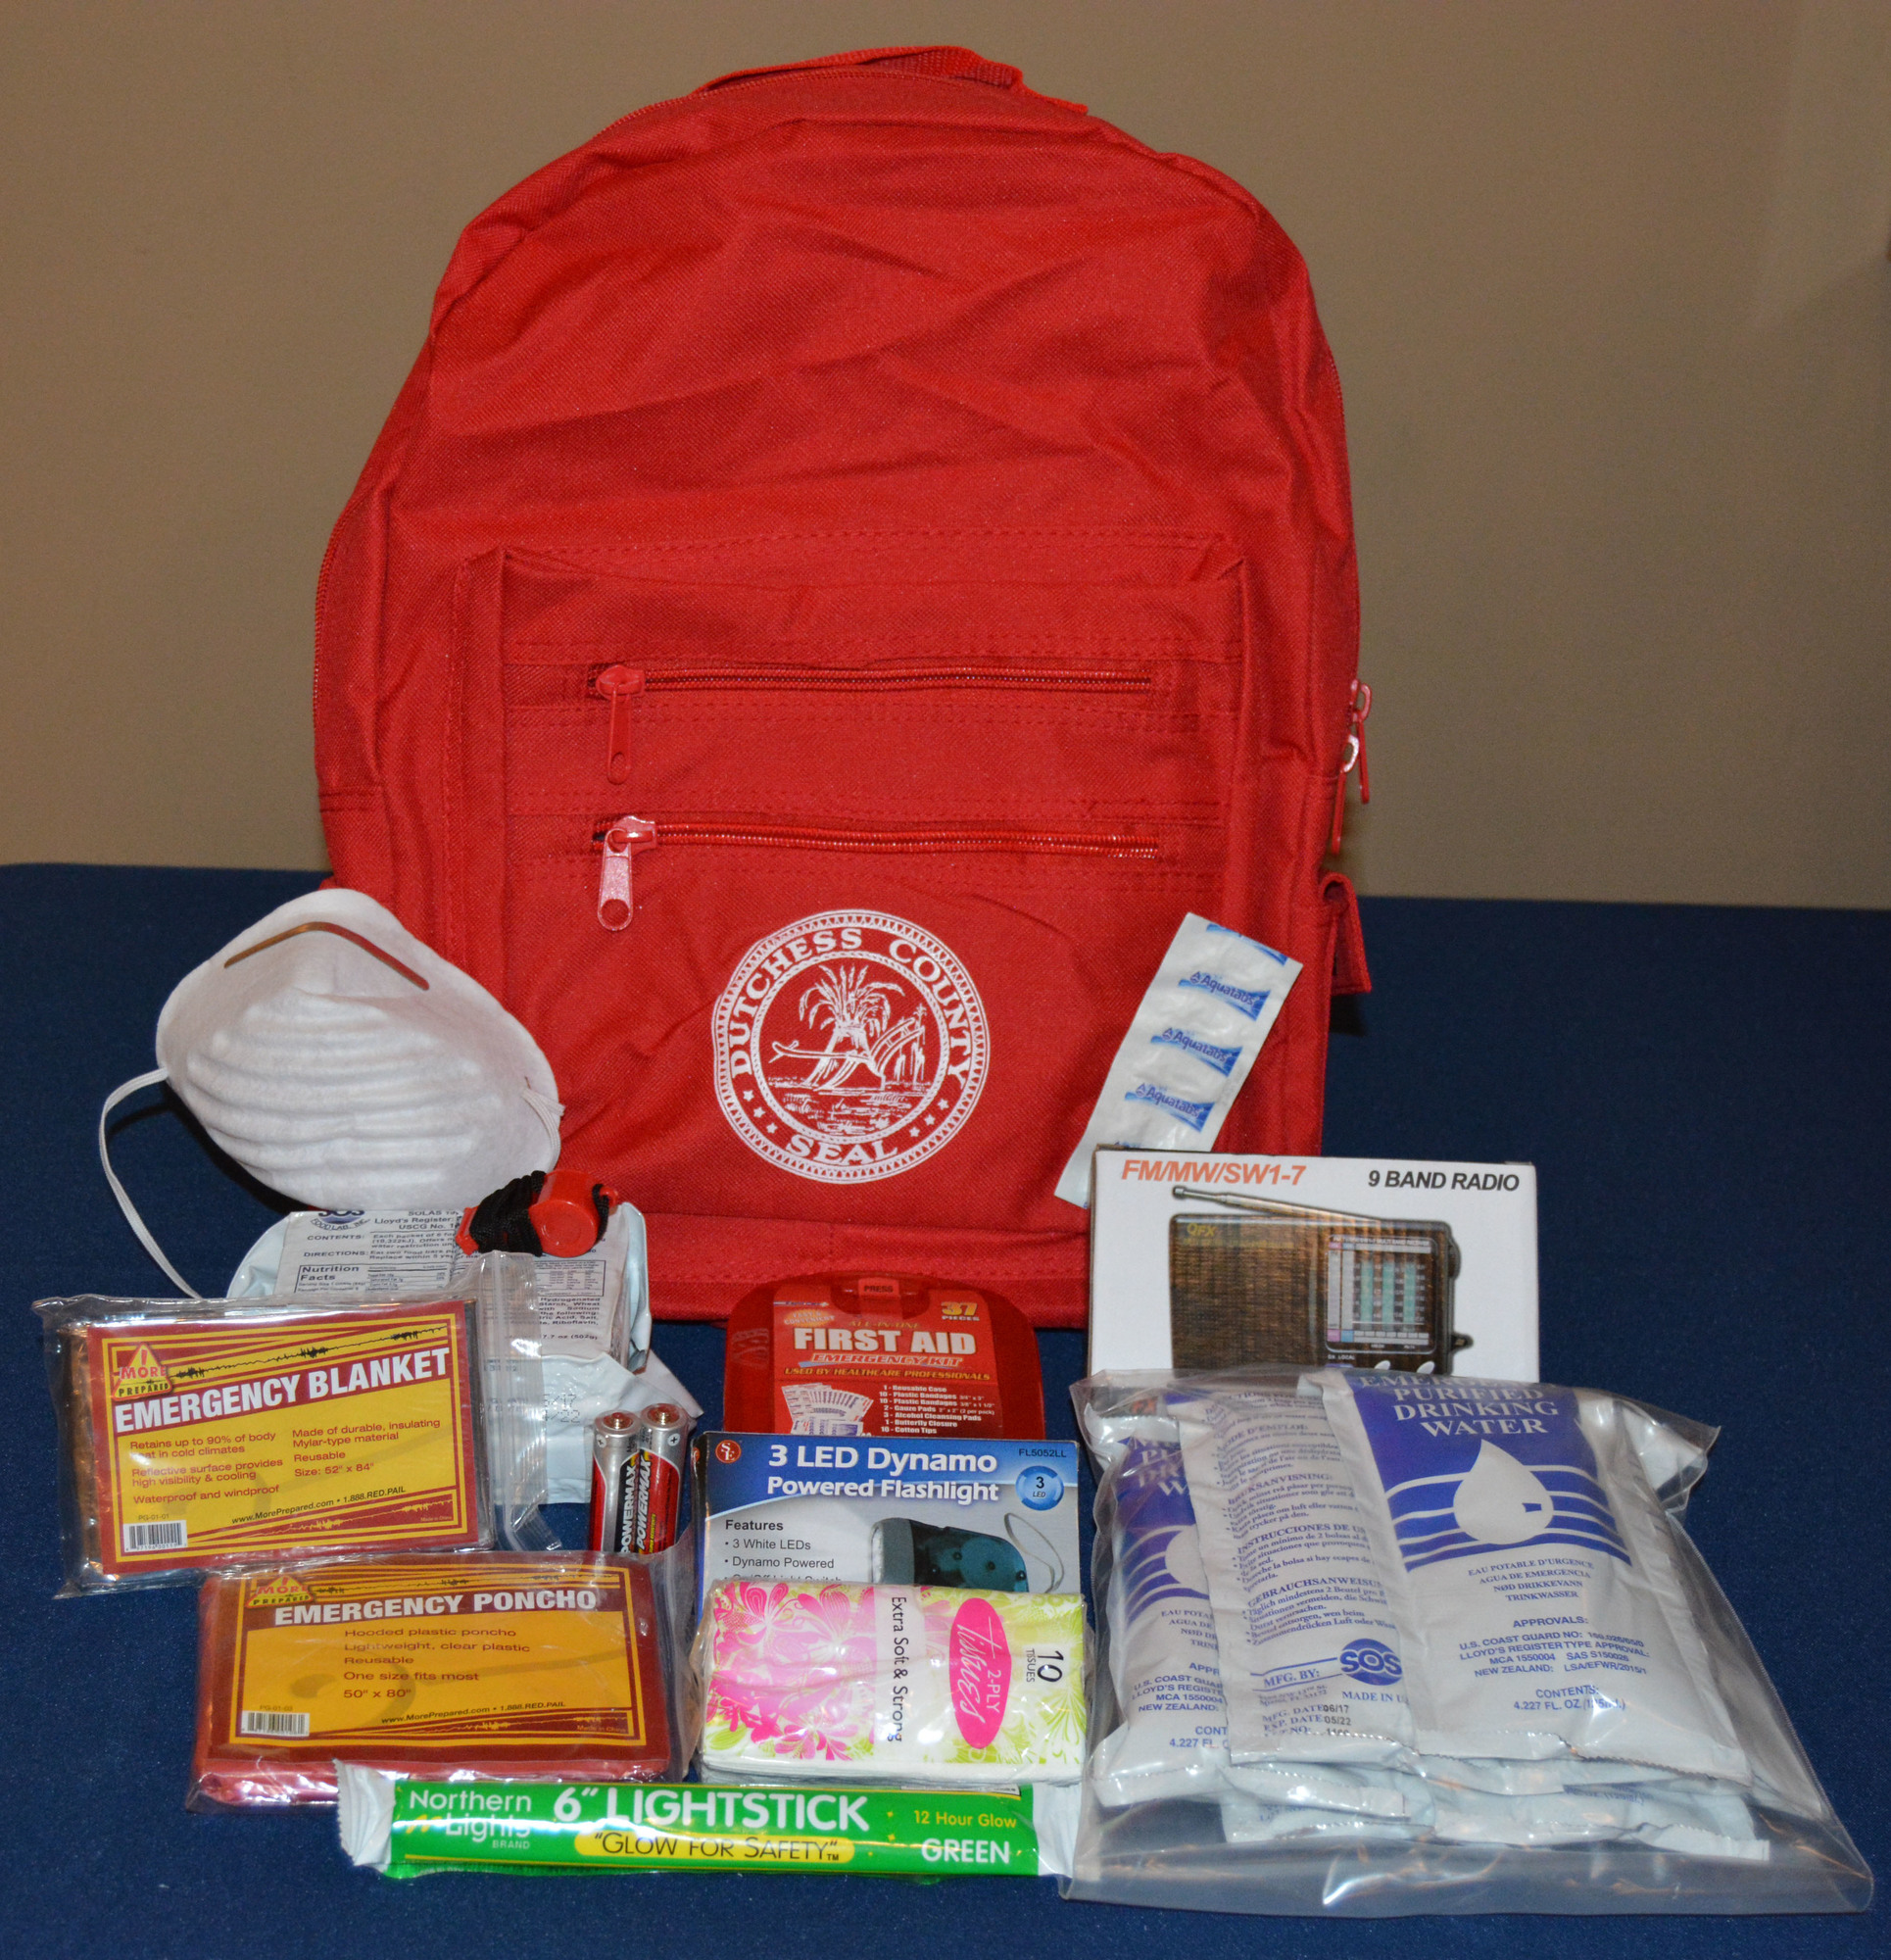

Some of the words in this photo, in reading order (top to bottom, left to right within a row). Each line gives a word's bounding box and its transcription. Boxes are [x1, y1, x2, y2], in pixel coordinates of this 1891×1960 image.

[1200, 974, 1255, 1006] Aquatabs
[729, 927, 862, 1078] DUTCHESS
[888, 938, 972, 1090] COUNTY
[1173, 1030, 1228, 1062] Aquatabs
[1145, 1086, 1200, 1118] Aquatabs
[785, 1133, 897, 1165] SEAL
[1121, 1159, 1307, 1186] FM/MW/SW1-7
[1368, 1170, 1381, 1188] 9
[1384, 1171, 1447, 1190] BAND
[1451, 1173, 1521, 1192] RADIO
[1187, 1222, 1215, 1237] QFX
[941, 1300, 978, 1316] 37
[794, 1327, 900, 1352] FIRST
[909, 1331, 976, 1354] AID
[811, 1352, 927, 1367] EMERGENCY
[927, 1356, 964, 1367] KIT
[120, 1366, 167, 1380] MORE
[834, 1368, 901, 1377] HEALTHCARE
[904, 1370, 991, 1381] PROFESSIONALS
[115, 1374, 301, 1433] EMERGENCY
[308, 1347, 451, 1399] BLANKET
[119, 1383, 169, 1396] PREPARED
[1393, 1388, 1544, 1401] PURIFIED
[1393, 1401, 1559, 1421] DRINKING
[293, 1428, 324, 1439] Made
[327, 1426, 339, 1436] of
[342, 1422, 386, 1435] durable,
[389, 1418, 441, 1432] insulating
[1421, 1419, 1548, 1438] WATER
[130, 1441, 171, 1449] Retains
[207, 1436, 231, 1445] 90%
[234, 1434, 246, 1443] of
[249, 1432, 276, 1442] body
[293, 1436, 351, 1448] Mylar-type
[354, 1431, 399, 1443] material
[171, 1448, 195, 1457] cold
[198, 1446, 245, 1455] climates
[294, 1450, 346, 1462] Reusable
[768, 1445, 787, 1466] 3
[797, 1446, 859, 1468] LED
[867, 1447, 997, 1476] Dynamo
[1018, 1447, 1067, 1458] FL5052LL
[132, 1467, 186, 1477] Reflective
[190, 1463, 232, 1474] surface
[235, 1458, 283, 1472] provides
[294, 1467, 321, 1478] Size:
[324, 1464, 343, 1475] 52"
[356, 1462, 374, 1472] 84"
[132, 1478, 156, 1488] high
[159, 1474, 201, 1486] visibility
[217, 1470, 257, 1482] cooling
[1035, 1476, 1045, 1490] 3
[133, 1492, 197, 1504] Waterproof
[200, 1491, 221, 1499] and
[224, 1485, 280, 1498] windproof
[767, 1476, 875, 1497] Powered
[881, 1480, 999, 1504] Flashlight
[232, 1497, 334, 1524] www.MorePrepared.com
[343, 1486, 407, 1502] 1.888.RED.PAIL
[637, 1456, 652, 1549] POWERMAX
[725, 1519, 784, 1532] Features
[732, 1539, 740, 1549] 3
[744, 1539, 780, 1550] White
[783, 1540, 811, 1550] LEDs
[732, 1556, 781, 1570] Dynamo
[783, 1557, 835, 1569] Powered
[1468, 1566, 1489, 1577] EAU
[1491, 1560, 1536, 1572] POTABLE
[1537, 1557, 1595, 1570] D'URGENCE
[1479, 1575, 1508, 1585] AGUA
[1525, 1569, 1591, 1579] EMERGENCIA
[1493, 1584, 1516, 1592] NØD
[1518, 1580, 1583, 1590] DRIKKEVANN
[257, 1585, 309, 1594] MORE
[1505, 1591, 1579, 1601] TRINKWASSER
[253, 1594, 311, 1605] PREPARED
[274, 1594, 464, 1626] EMERGENCY
[474, 1590, 597, 1612] PONCHO
[892, 1596, 906, 1632] Extra
[1513, 1616, 1589, 1628] APPROVALS:
[345, 1629, 404, 1638] Hooded
[409, 1628, 457, 1638] plastic
[461, 1628, 516, 1638] poncho
[344, 1642, 435, 1652] Lightweight,
[440, 1642, 477, 1651] clear
[482, 1642, 530, 1652] plastic
[893, 1637, 908, 1667] Soft
[1460, 1647, 1506, 1660] LLOYD'S
[1509, 1642, 1563, 1652] REGISTER
[1595, 1642, 1650, 1657] APPROVAL:
[344, 1656, 413, 1665] Reusable
[1026, 1648, 1037, 1683] TISSUES
[1038, 1650, 1064, 1682] 10
[1339, 1649, 1403, 1676] SOS
[343, 1672, 374, 1681] One
[379, 1672, 410, 1681] size
[413, 1672, 437, 1681] fits
[441, 1672, 479, 1681] most
[894, 1669, 907, 1679] &
[1263, 1672, 1296, 1688] MFG.
[1299, 1669, 1321, 1680] BY:
[343, 1689, 368, 1698] 50"
[386, 1689, 412, 1698] 80"
[987, 1670, 1001, 1713] 2-PLY
[1535, 1685, 1599, 1698] CONTENTS:
[381, 1707, 490, 1724] www.MorePrepared.com
[500, 1701, 565, 1712] 1.888.RED.PAIL
[886, 1684, 908, 1742] Strong
[1263, 1709, 1288, 1722] MFG.
[1293, 1704, 1323, 1715] DATE
[1323, 1704, 1349, 1714] 06/17
[1290, 1714, 1323, 1724] DATE
[1325, 1716, 1352, 1726] 05/22
[410, 1789, 532, 1812] Northern
[606, 1788, 870, 1832] LIGHTSTICK
[446, 1812, 531, 1842] Lights
[913, 1810, 930, 1825] 12
[936, 1811, 974, 1827] Hour
[978, 1812, 1017, 1829] Glow
[492, 1839, 530, 1850] BRAND
[689, 1836, 735, 1858] FOR
[921, 1838, 1009, 1865] GREEN
